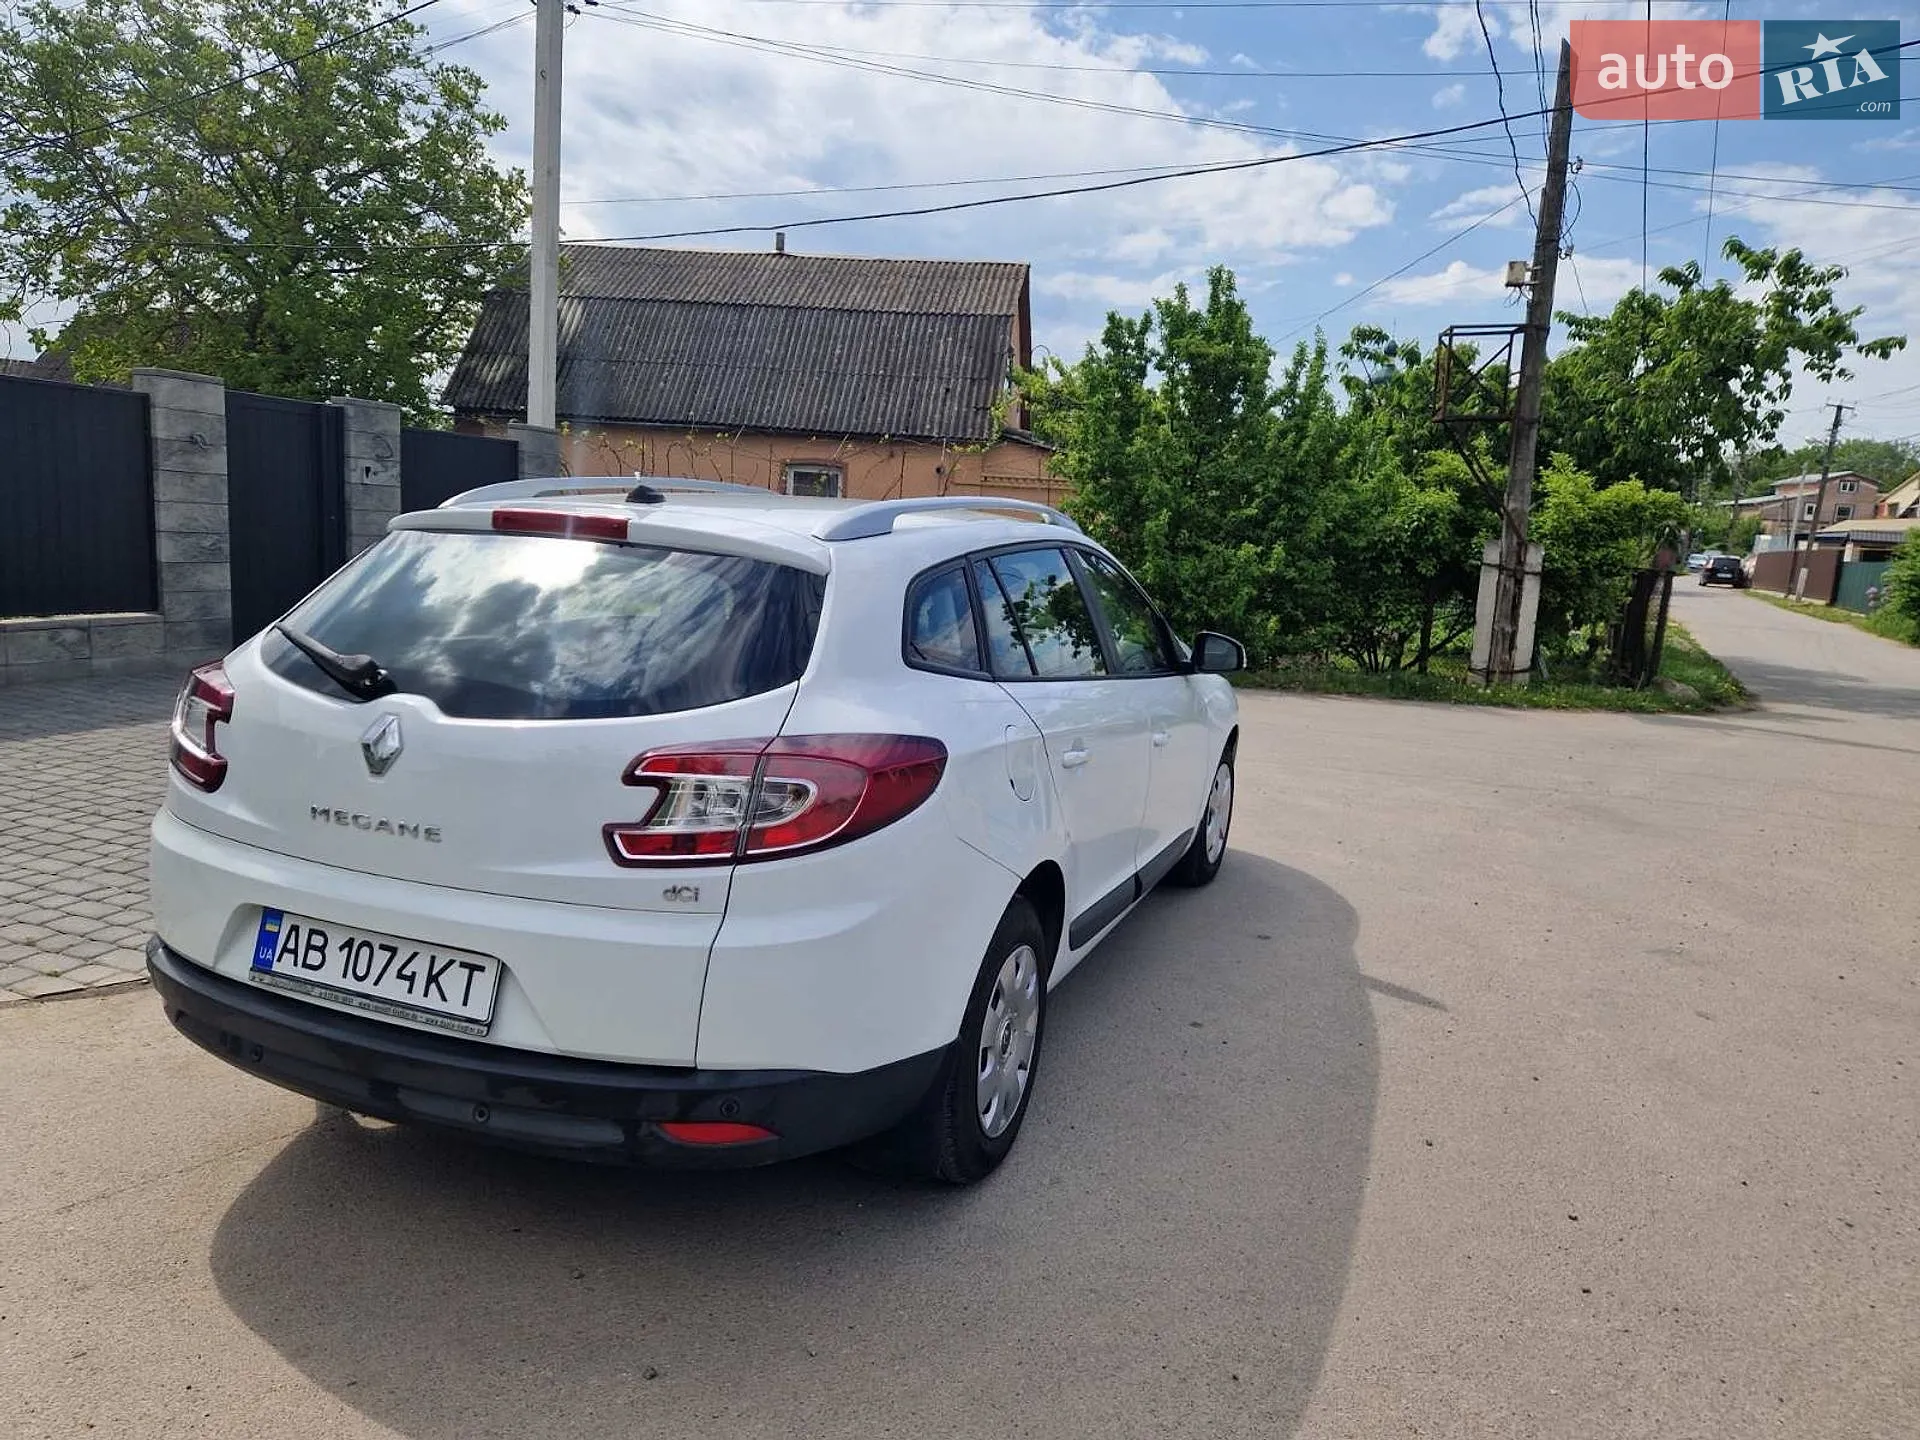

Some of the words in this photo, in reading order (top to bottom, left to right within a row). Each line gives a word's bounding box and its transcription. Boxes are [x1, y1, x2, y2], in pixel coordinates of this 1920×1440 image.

[310, 804, 442, 843] MEGANE
[259, 946, 273, 961] UA
[276, 924, 329, 972] AB
